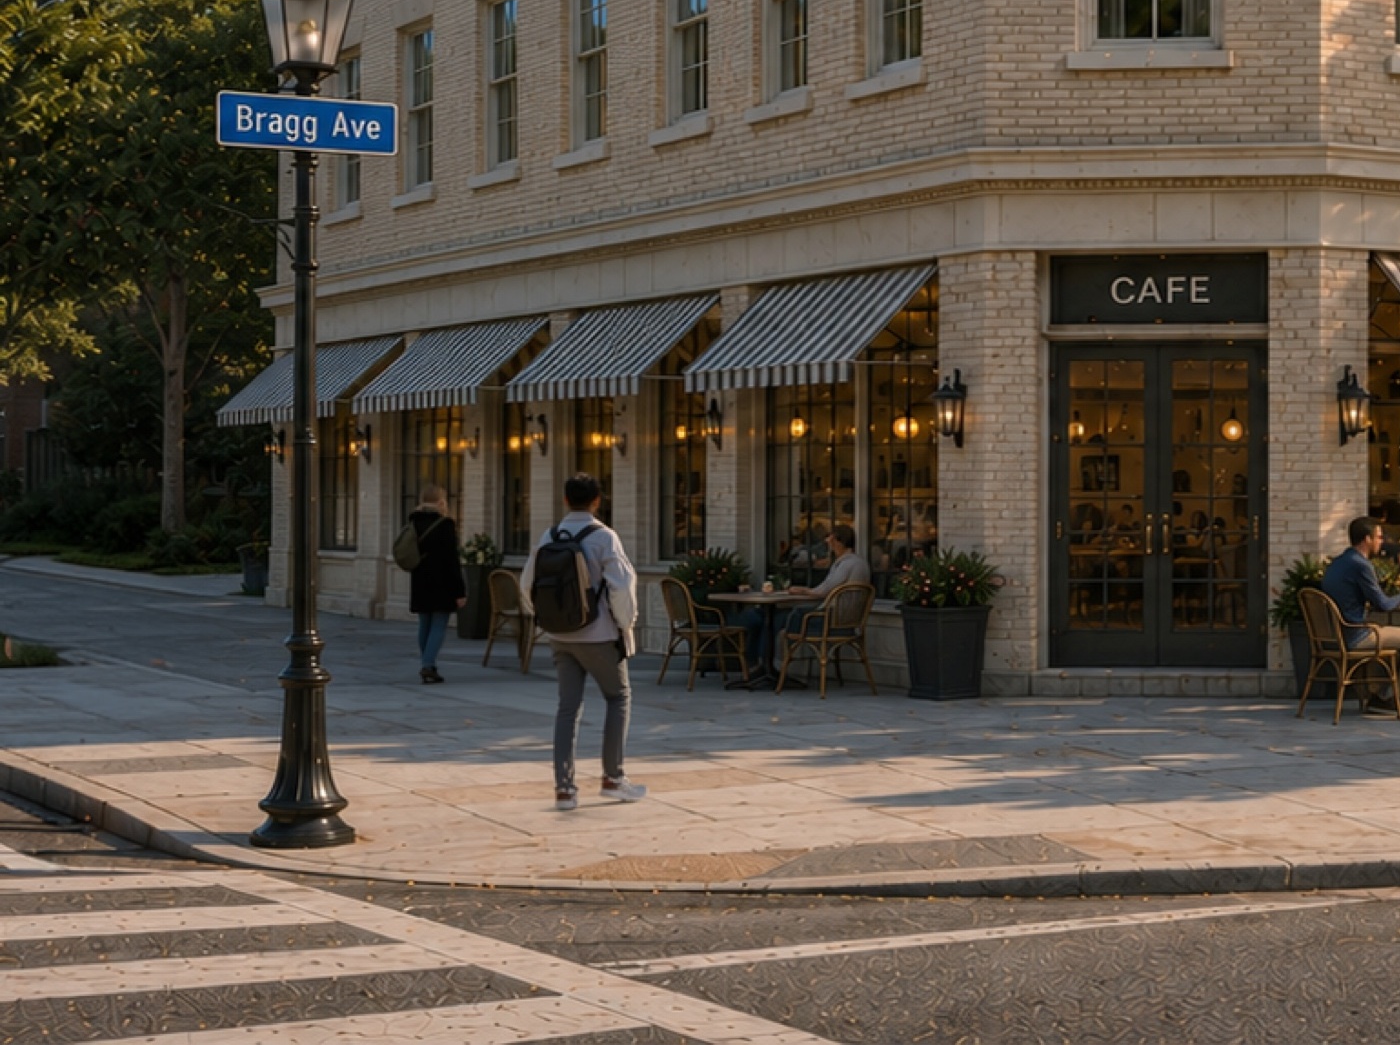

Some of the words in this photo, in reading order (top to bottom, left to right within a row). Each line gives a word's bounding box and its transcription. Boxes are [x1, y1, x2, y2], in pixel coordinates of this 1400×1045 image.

[236, 104, 318, 143] Bragg
[332, 111, 381, 140] Ave
[1110, 276, 1211, 304] CAFE
